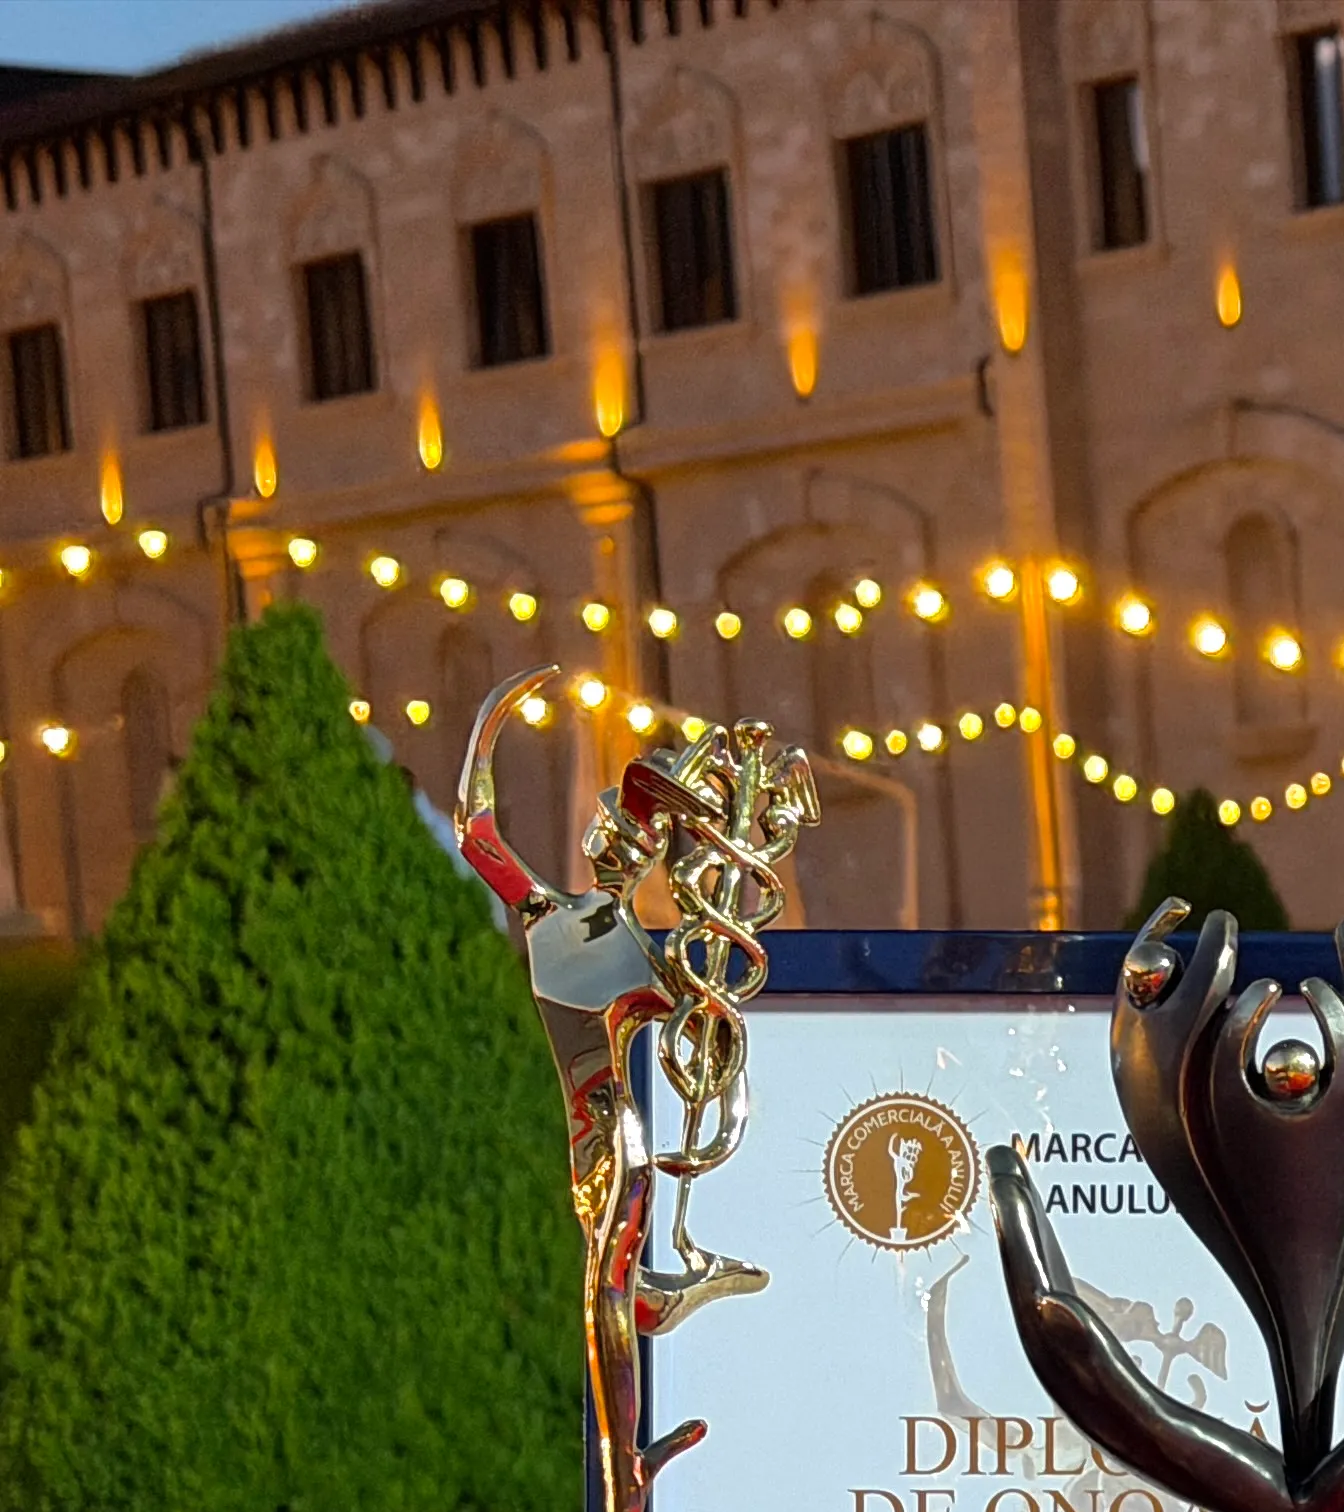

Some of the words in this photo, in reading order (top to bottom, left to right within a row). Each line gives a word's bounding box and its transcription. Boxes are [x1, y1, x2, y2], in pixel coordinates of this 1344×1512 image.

[847, 1108, 946, 1150] COMERCIALĂ
[1011, 1132, 1144, 1163] MARCA
[838, 1152, 864, 1213] MARCA
[938, 1149, 966, 1214] ANULUI
[1045, 1184, 1182, 1214] ANULU
